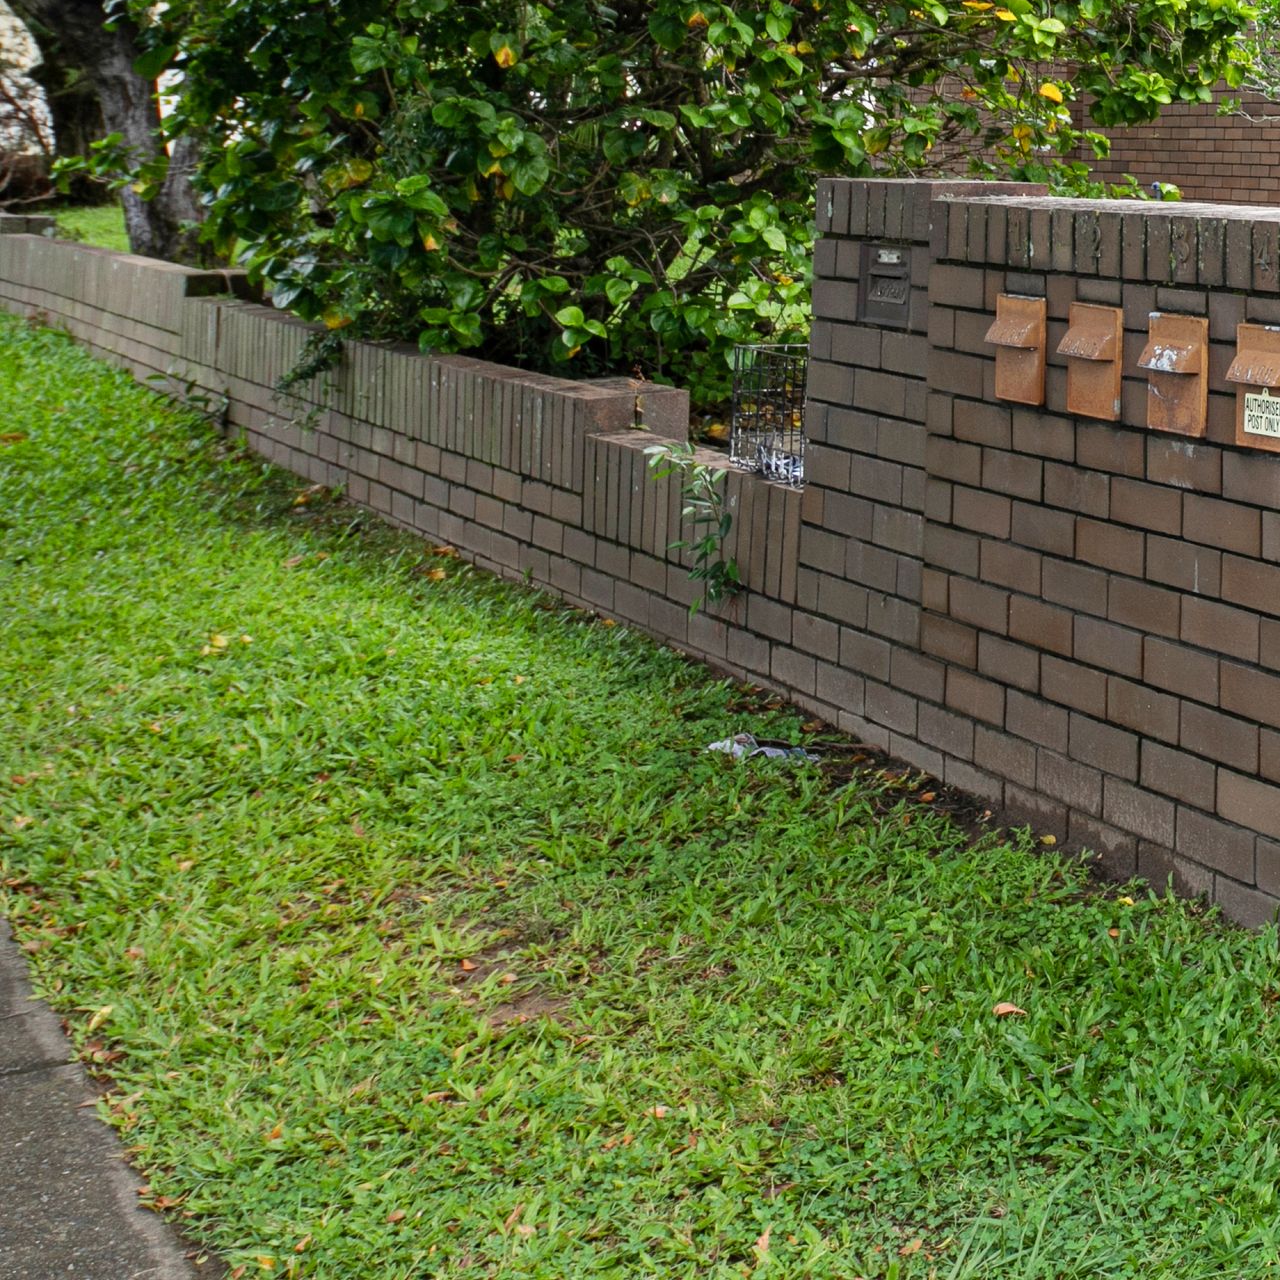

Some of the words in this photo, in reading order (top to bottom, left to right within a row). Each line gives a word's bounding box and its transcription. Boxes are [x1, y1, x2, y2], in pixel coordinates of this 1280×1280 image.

[1177, 229, 1190, 264] 3
[1256, 230, 1272, 271] 4
[1247, 415, 1263, 431] POST
[1264, 416, 1280, 433] ONLY
